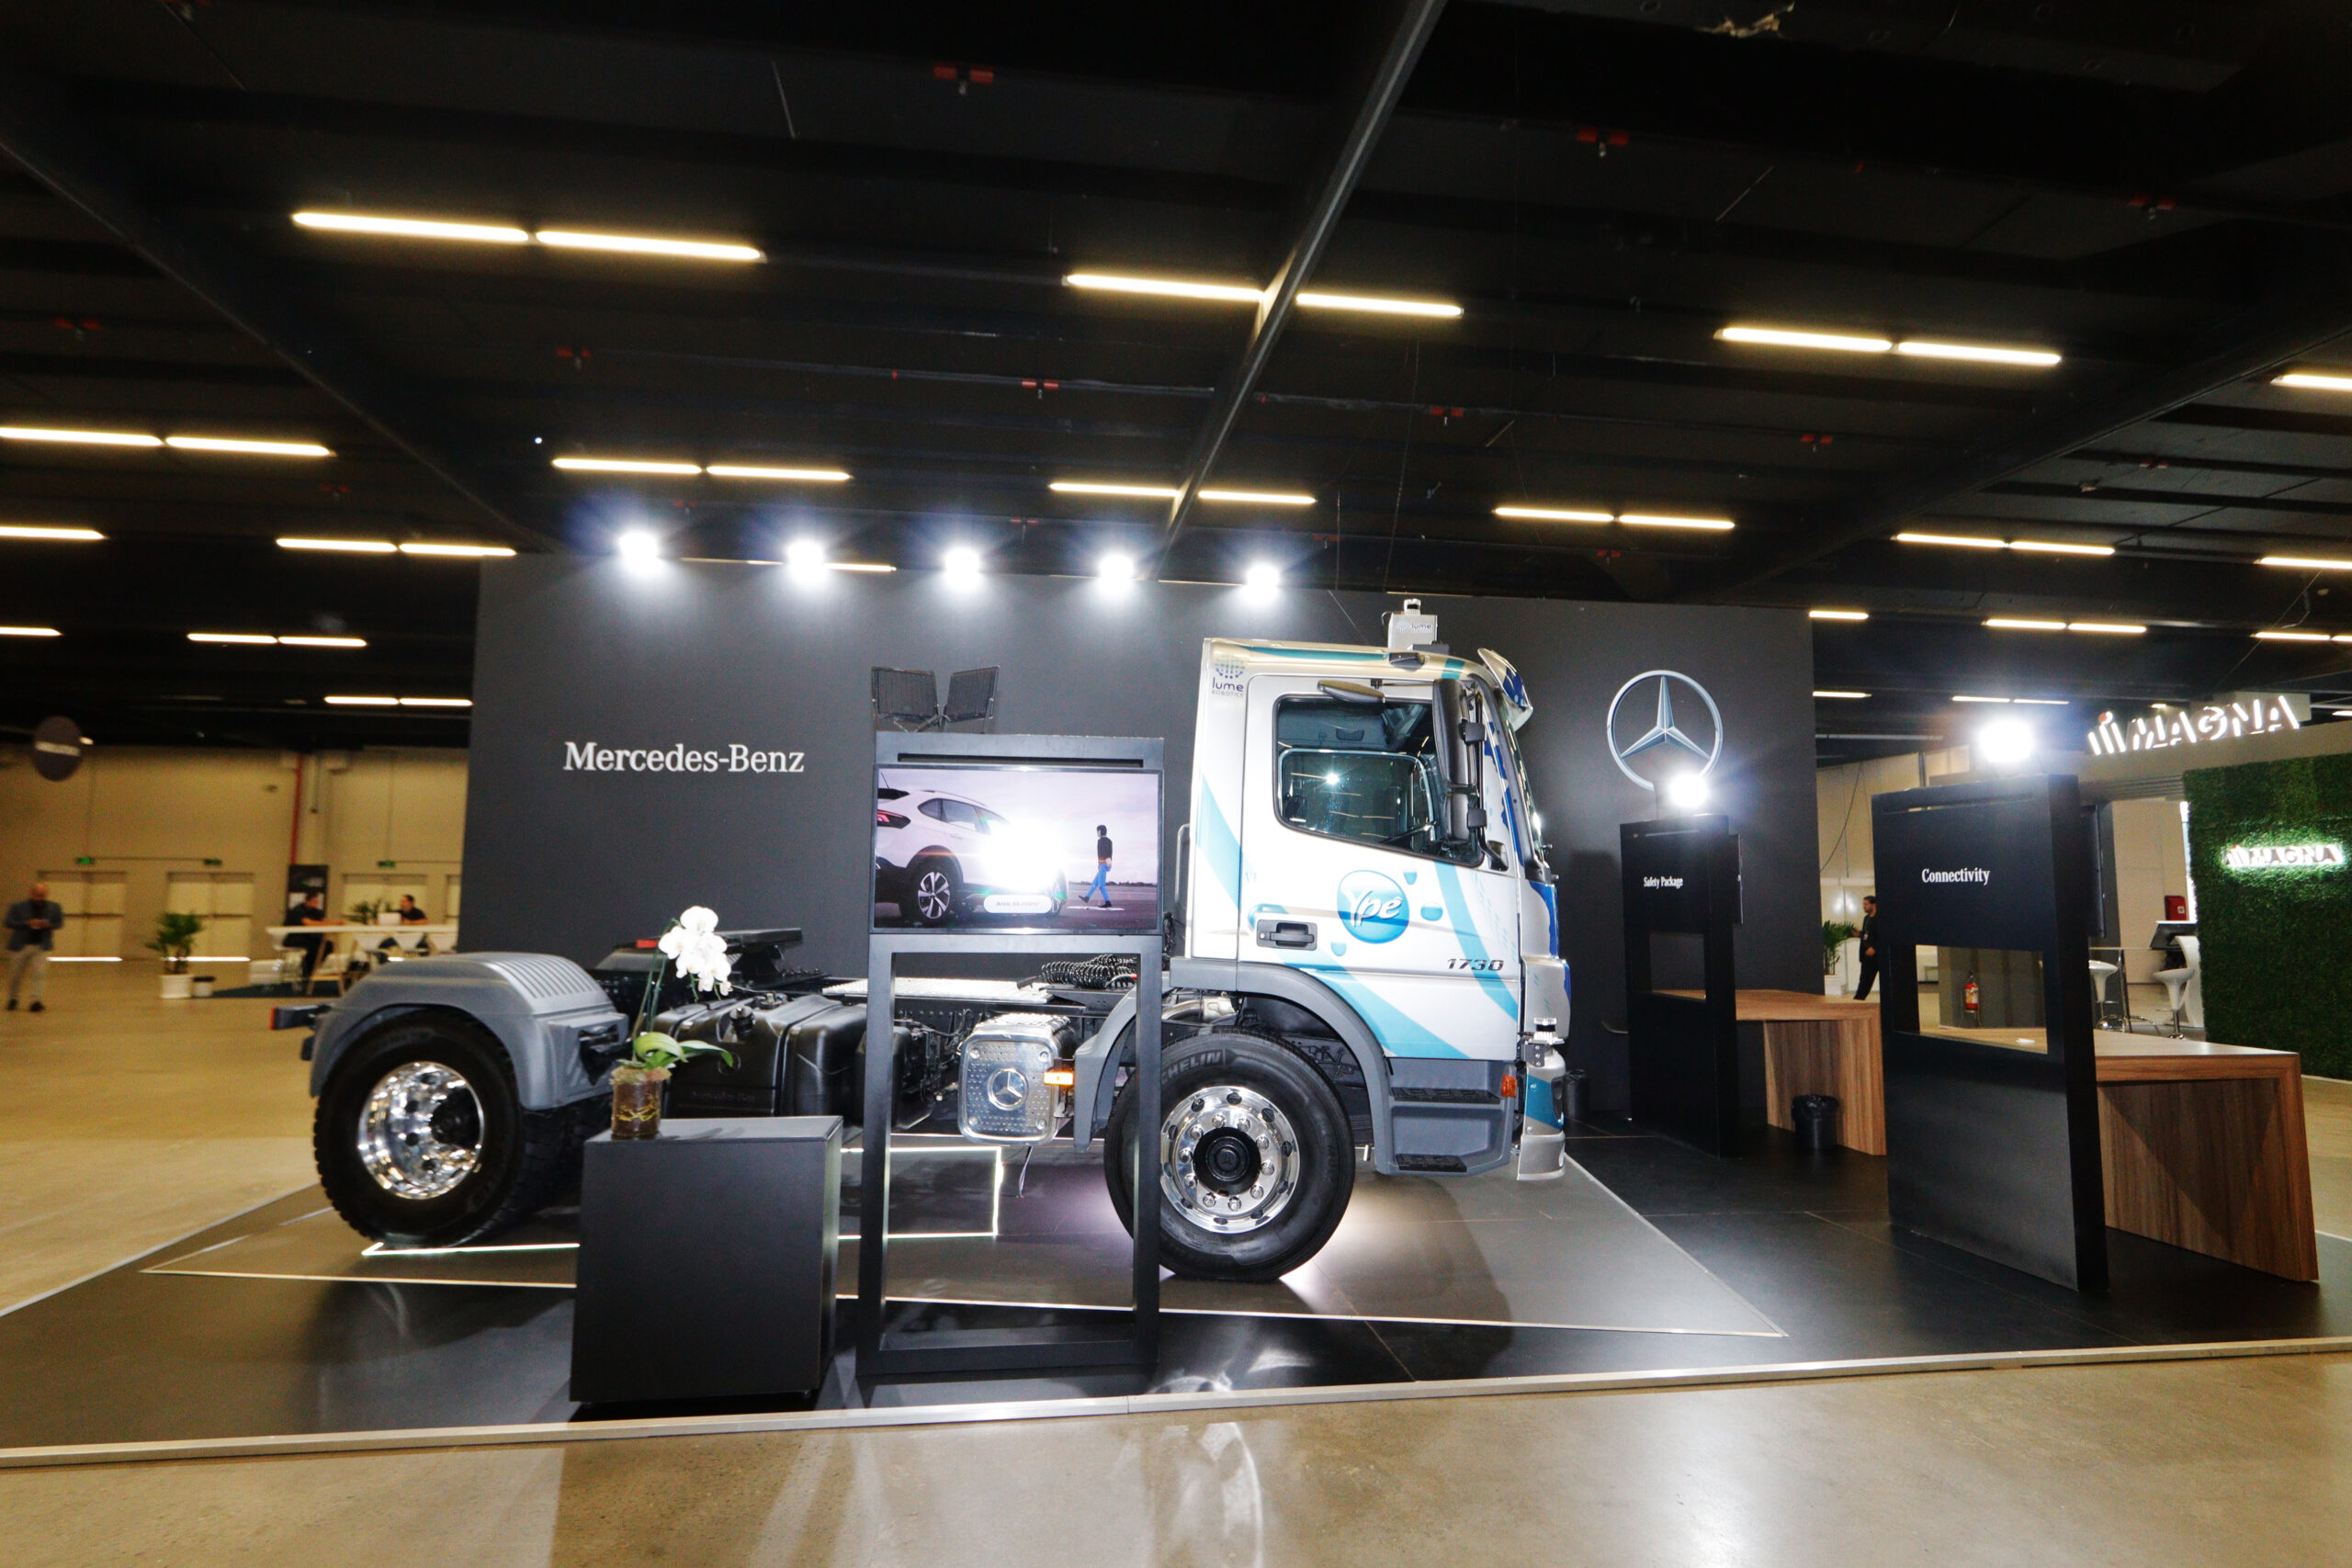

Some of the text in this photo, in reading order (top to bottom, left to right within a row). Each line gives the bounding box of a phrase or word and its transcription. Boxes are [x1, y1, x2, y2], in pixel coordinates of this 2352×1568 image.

[1213, 676, 1244, 692] lume
[2126, 695, 2300, 751] MAGNA
[563, 741, 805, 773] Mercedes-Benz
[2248, 843, 2344, 865] MAGNA
[1644, 875, 1684, 889] Safety Package
[1921, 867, 1990, 886] Connectivity
[1447, 958, 1504, 972] 1730
